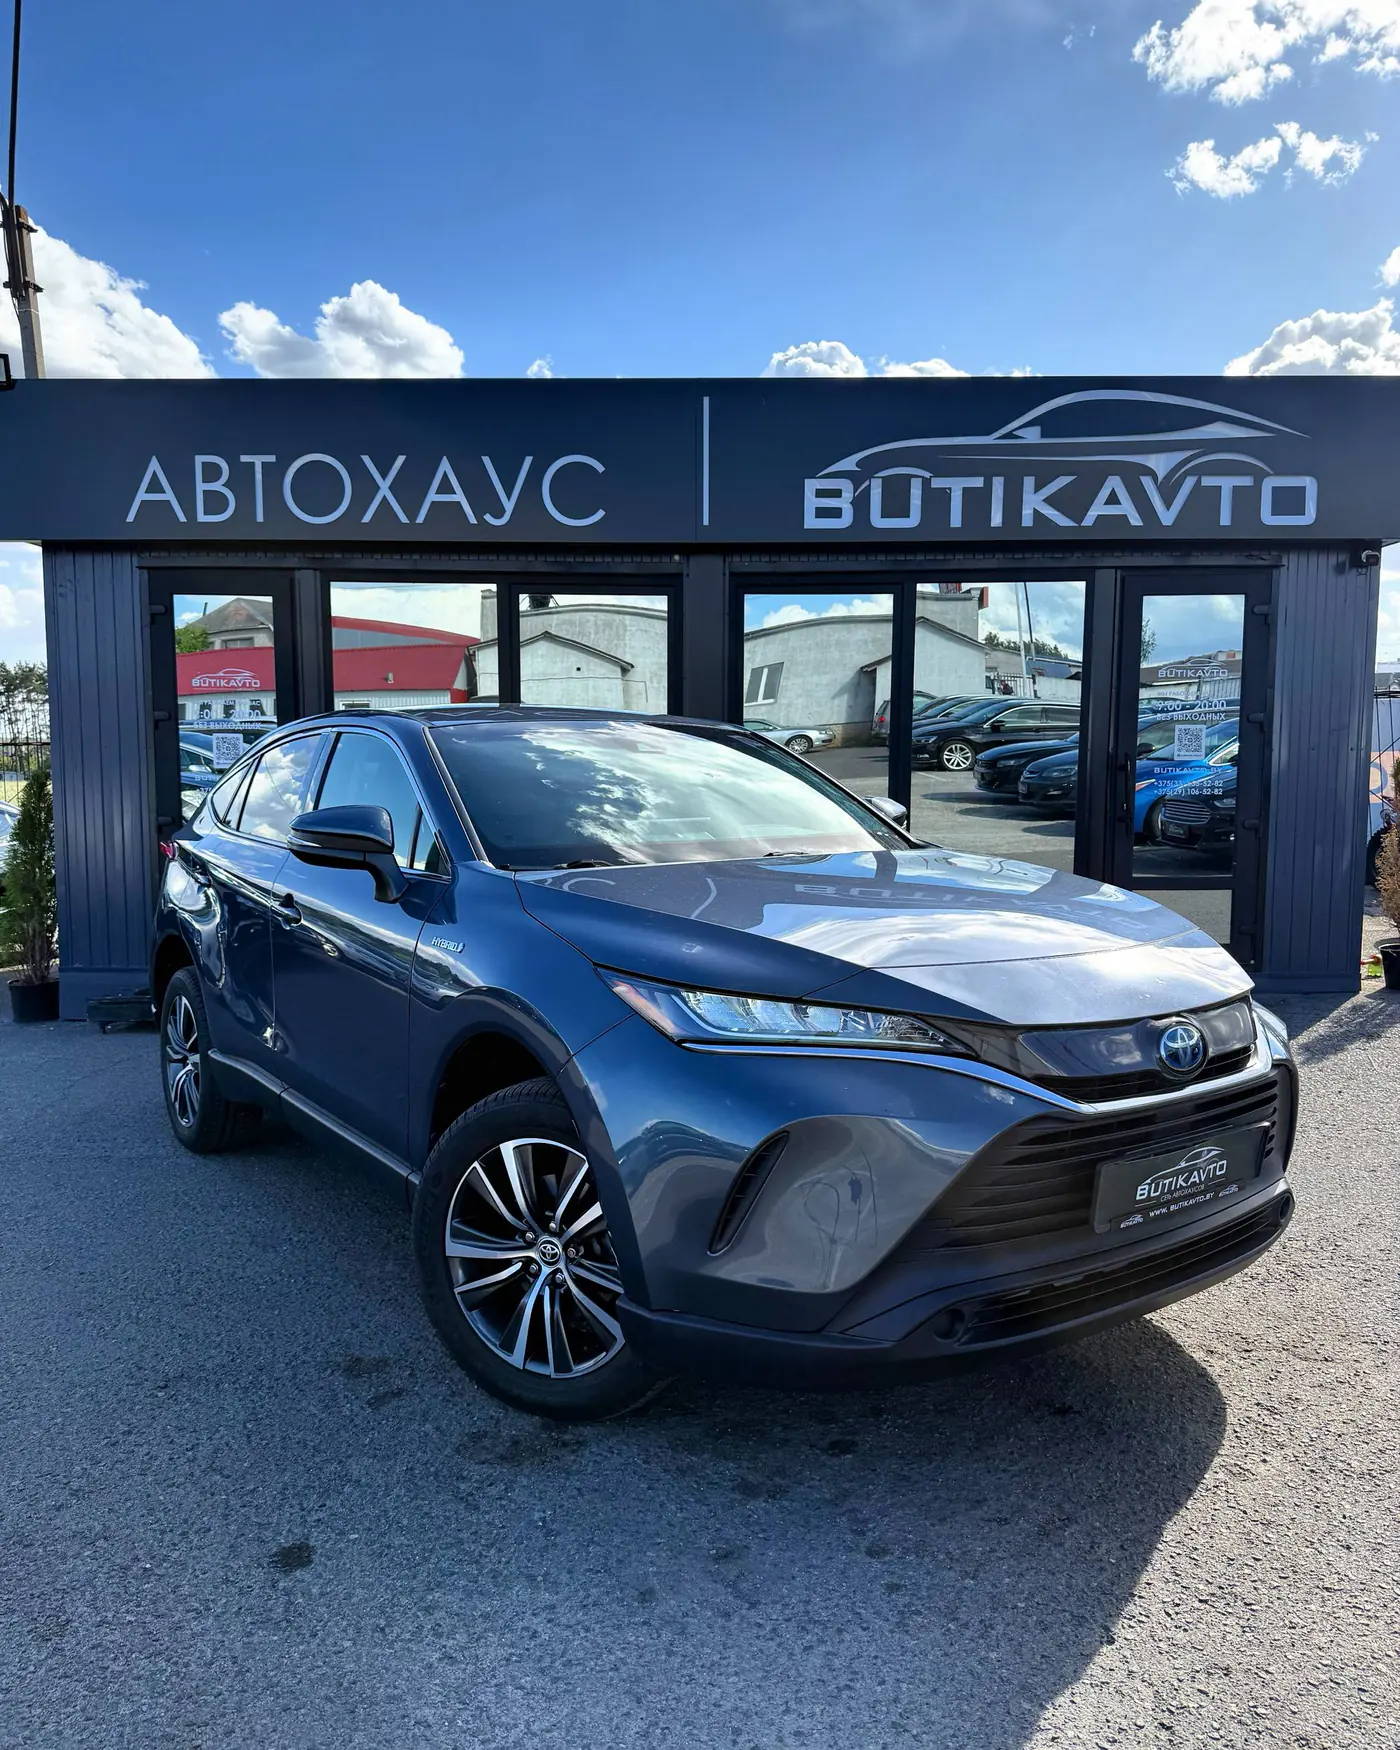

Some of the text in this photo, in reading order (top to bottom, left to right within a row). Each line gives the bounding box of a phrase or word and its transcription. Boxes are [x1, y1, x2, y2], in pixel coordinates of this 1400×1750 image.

[125, 453, 607, 527] АВТОХАУС
[803, 474, 1319, 530] BUTIKAVTO
[1158, 669, 1228, 678] BUTIKAVTO
[192, 678, 260, 688] BUTIKAVTO
[1194, 700, 1227, 711] 20:00
[1173, 712, 1226, 721] ВЫХОДНЫХ
[1187, 788, 1223, 796] 106-52-82
[431, 936, 458, 951] HYBRID
[1136, 1160, 1227, 1200] BUTIKAVTO
